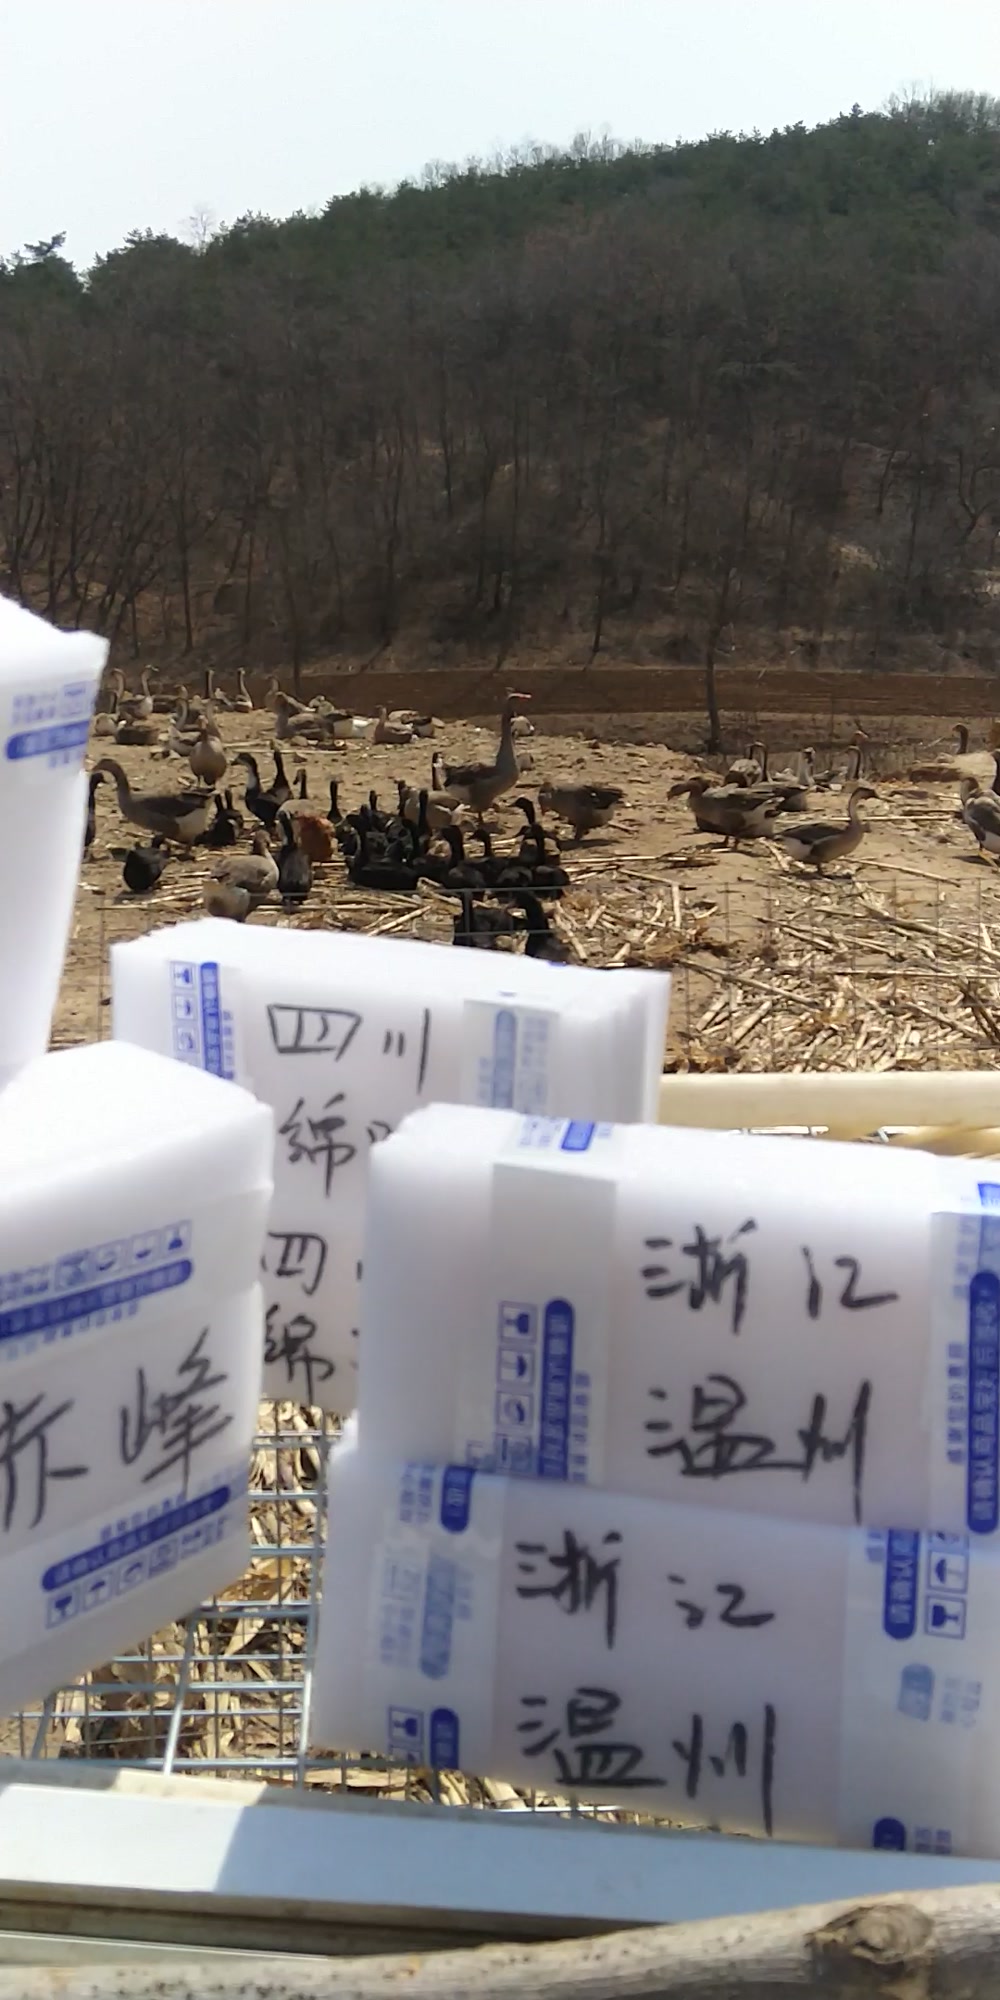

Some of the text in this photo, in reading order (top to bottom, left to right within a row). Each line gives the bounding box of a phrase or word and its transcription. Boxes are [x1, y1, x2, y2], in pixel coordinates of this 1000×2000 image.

[267, 1003, 430, 1094] 四川
[261, 1231, 363, 1296] 四
[642, 1219, 899, 1335] 浙江
[264, 1303, 358, 1405] 绵
[645, 1375, 872, 1522] 温州
[514, 1530, 775, 1649] 浙江
[515, 1687, 776, 1836] 温州
